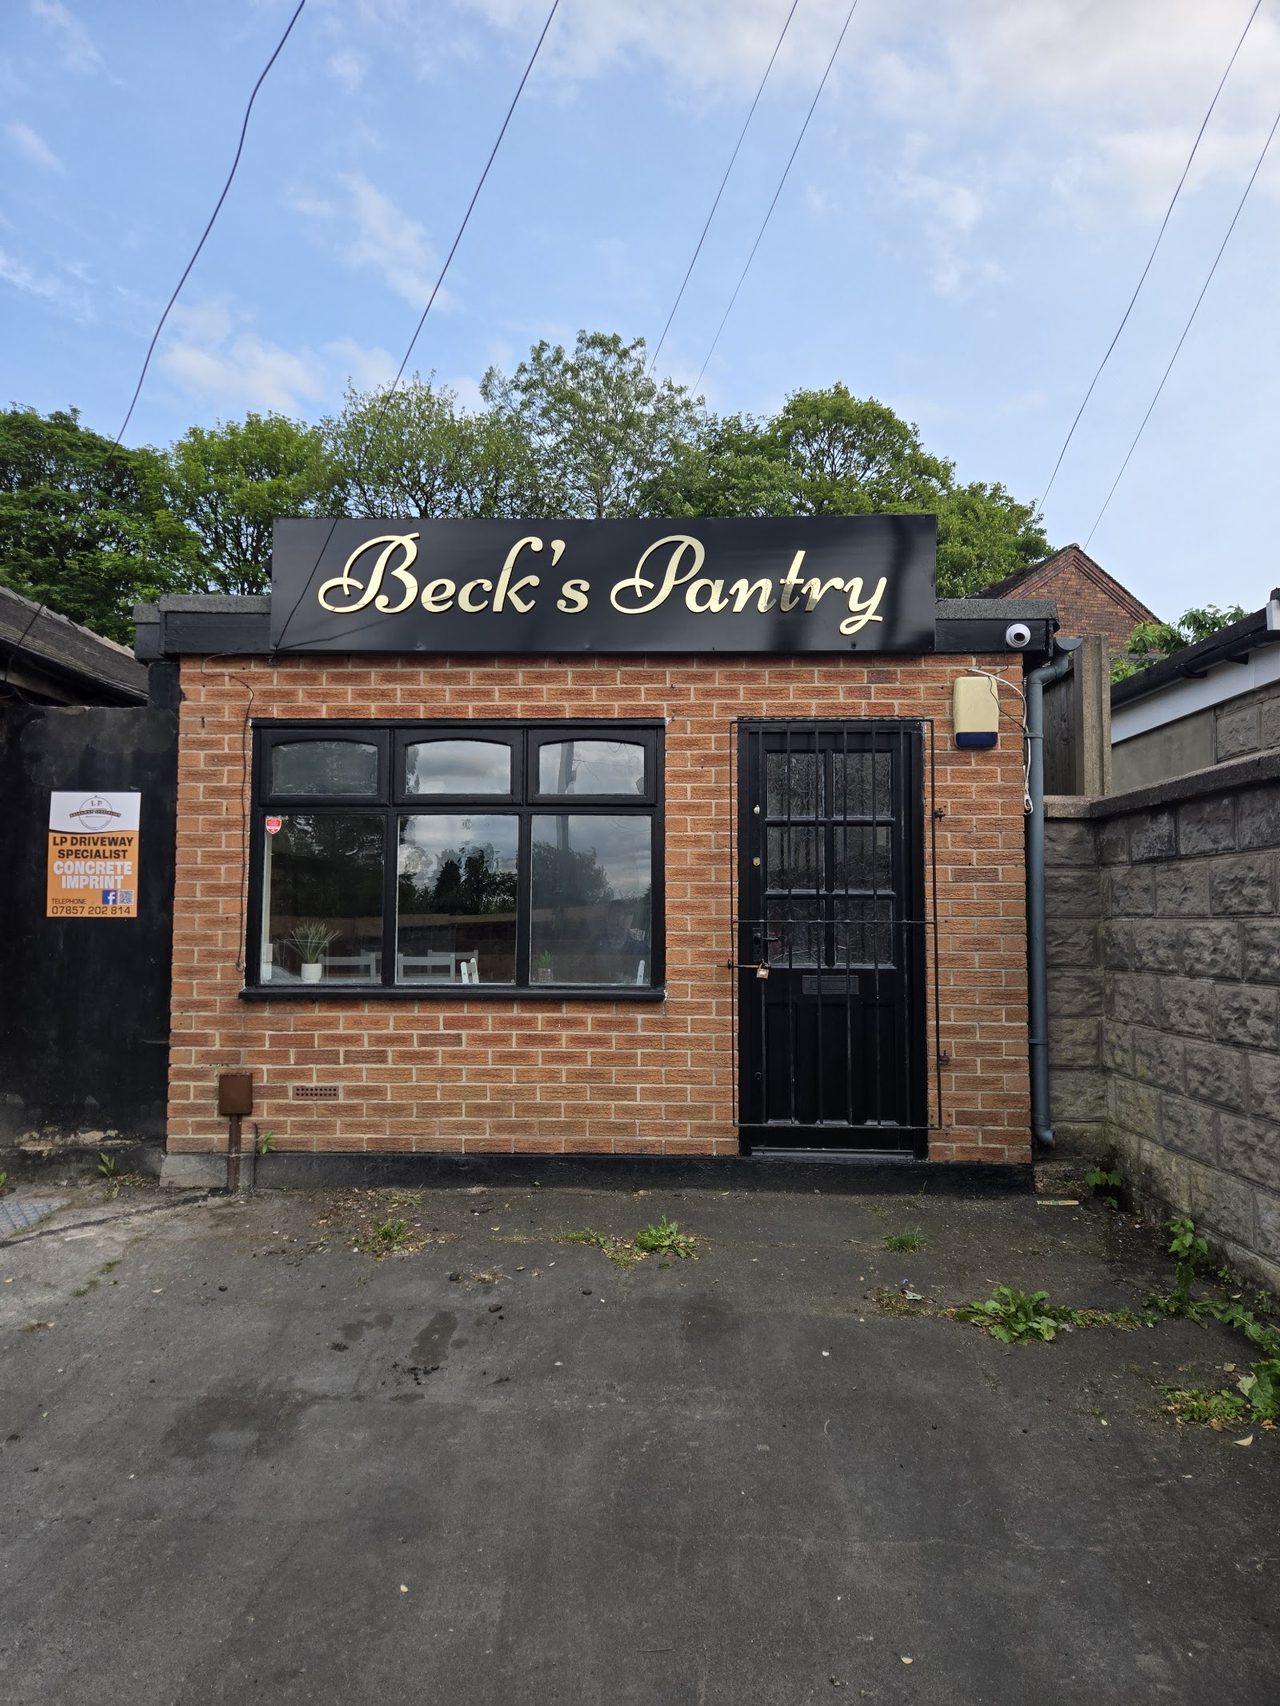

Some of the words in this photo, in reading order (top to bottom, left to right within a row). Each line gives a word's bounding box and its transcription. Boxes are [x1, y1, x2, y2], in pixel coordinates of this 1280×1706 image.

[318, 531, 590, 616] Beck's
[609, 534, 889, 636] Pantry
[52, 836, 68, 847] LP
[70, 836, 134, 847] DRIVEWAY
[57, 849, 128, 859] SPECIALIST
[53, 860, 133, 875] CONCRETE
[61, 875, 124, 889] IMPRINT
[51, 905, 86, 915] 07857
[88, 905, 108, 915] 202
[110, 905, 130, 915] 814
